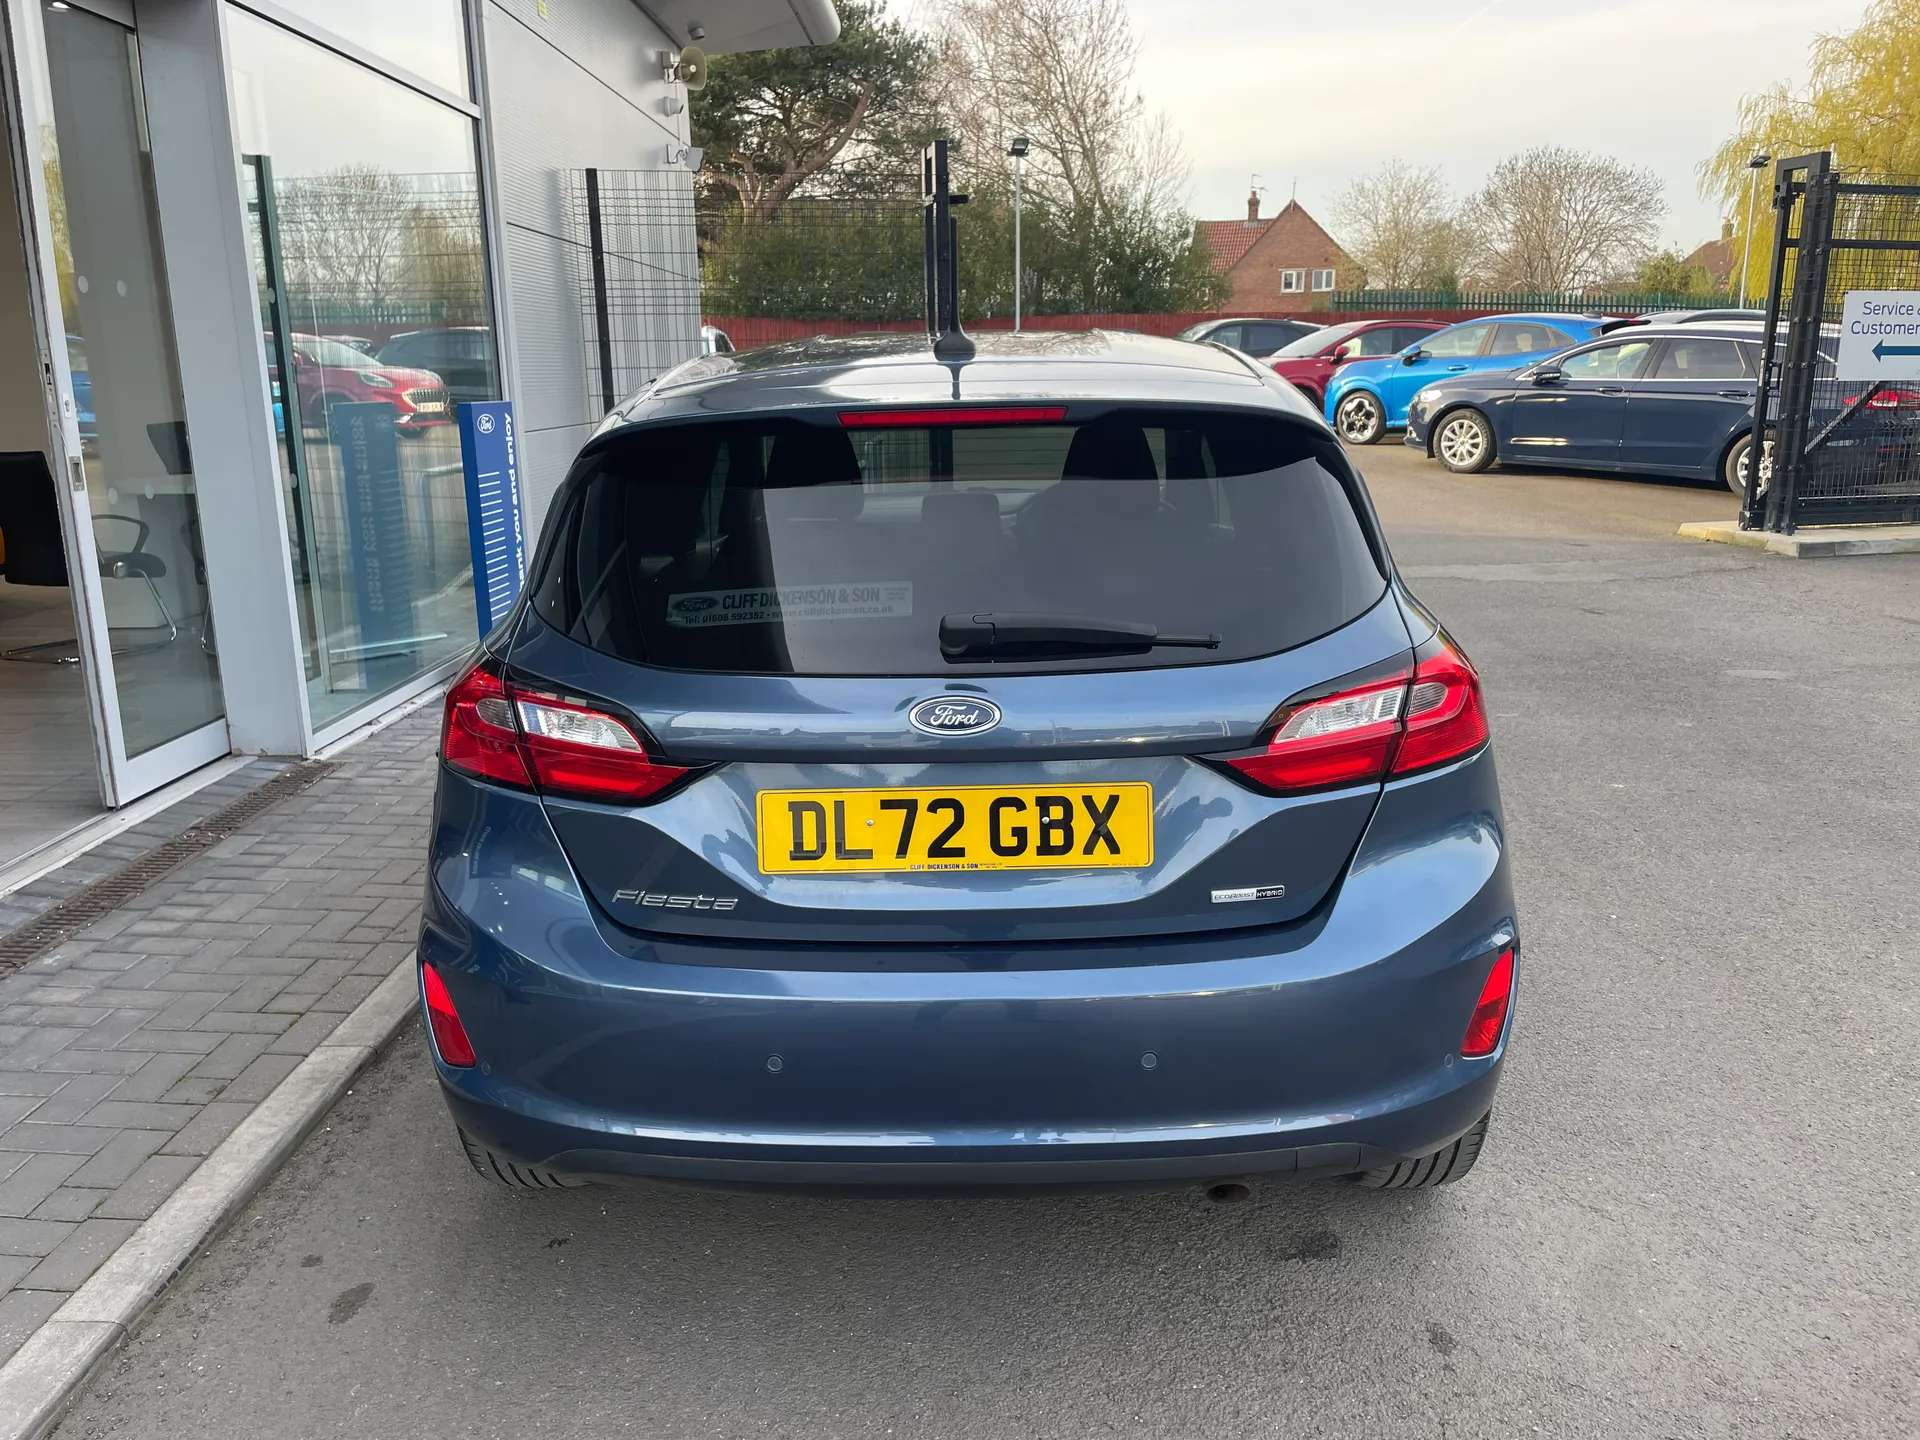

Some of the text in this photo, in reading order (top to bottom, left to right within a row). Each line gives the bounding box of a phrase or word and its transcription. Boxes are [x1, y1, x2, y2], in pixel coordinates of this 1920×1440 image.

[1863, 301, 1914, 315] Service
[1850, 320, 1920, 335] Customer
[505, 412, 524, 592] hank you and enjoy
[722, 593, 760, 610] CLIFF
[838, 587, 849, 603] &
[850, 586, 880, 602] SON
[930, 705, 979, 725] Ford
[988, 794, 1121, 857] GBX
[611, 889, 738, 910] Fiesta
[1256, 889, 1283, 897] HYBRID
